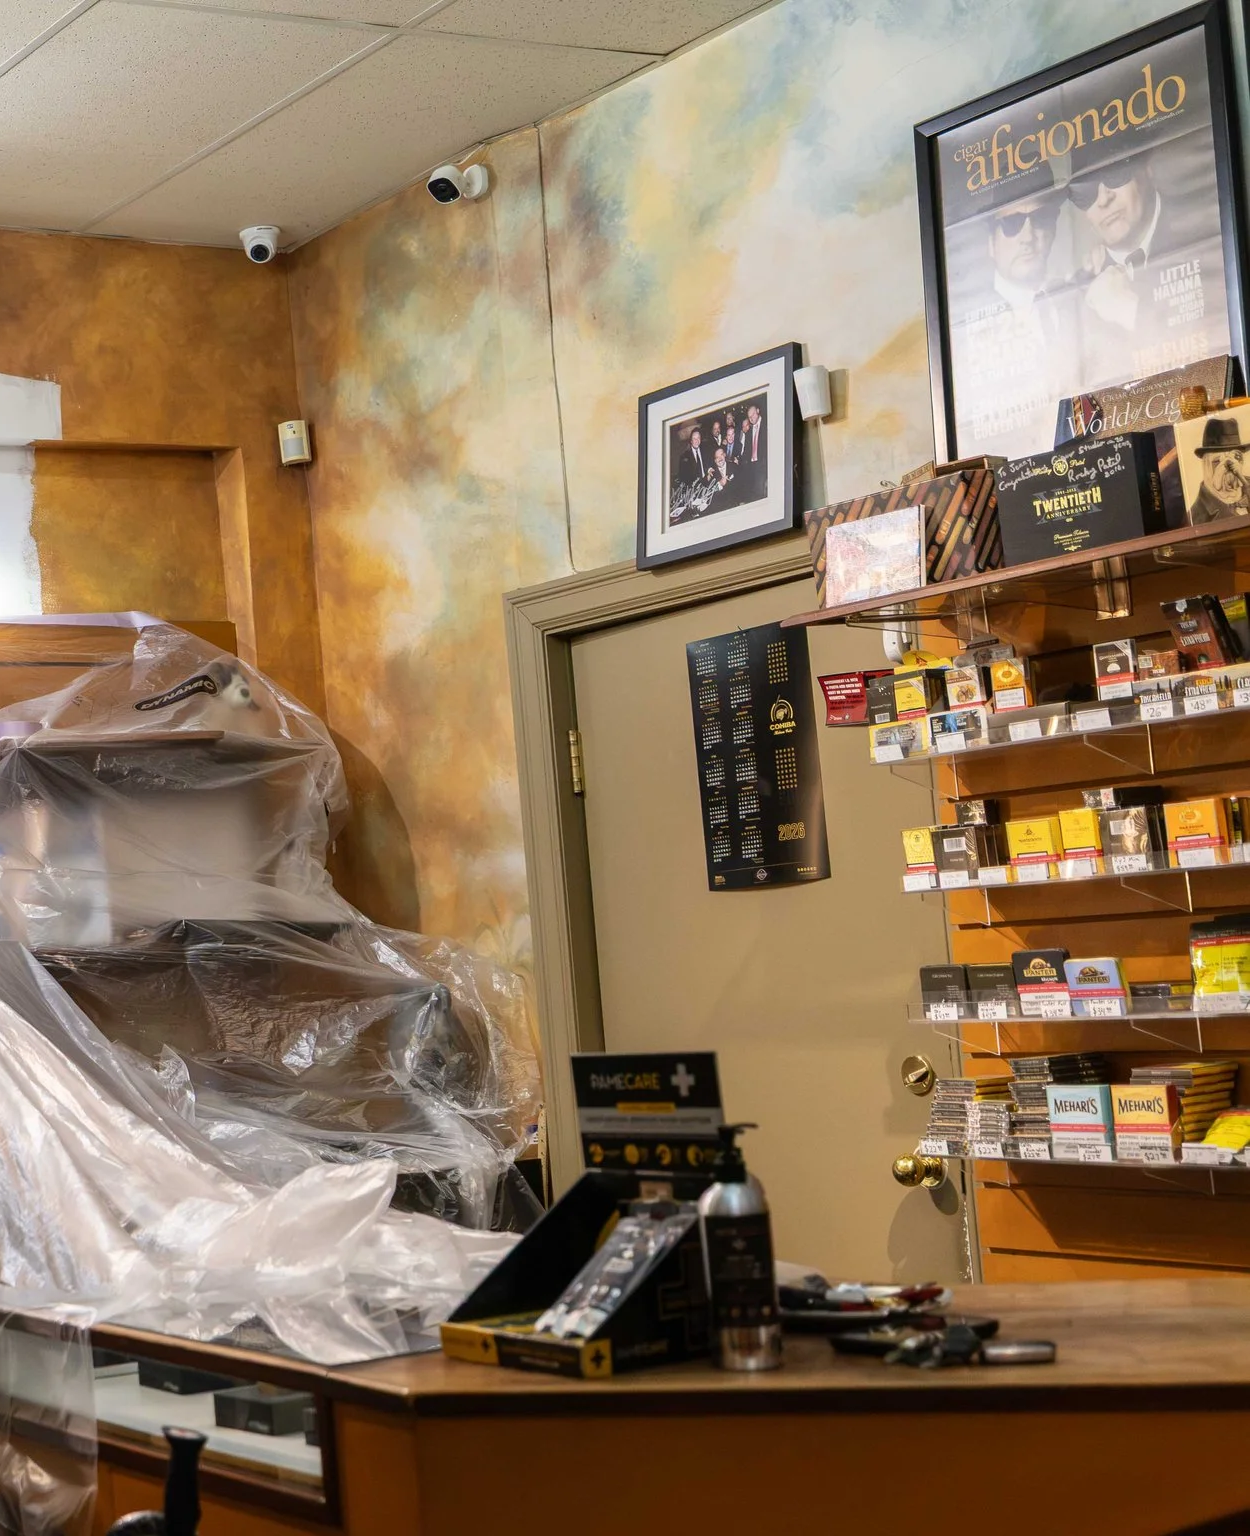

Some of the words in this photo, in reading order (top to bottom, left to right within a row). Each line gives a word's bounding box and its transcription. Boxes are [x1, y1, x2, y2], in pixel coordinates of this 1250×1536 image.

[966, 63, 1186, 192] aficionado
[953, 137, 989, 163] cigar
[1160, 259, 1201, 285] LITTLE
[1153, 274, 1203, 302] HAVANA
[1066, 401, 1132, 439] World
[1131, 403, 1143, 425] of
[1033, 486, 1103, 517] TWENTIETH
[1046, 505, 1092, 520] ANNIVERSARY
[140, 679, 216, 710] DYNAMIC
[770, 721, 796, 731] COHIBA
[778, 821, 806, 841] 2026
[1025, 969, 1055, 977] PANTER
[1053, 1097, 1098, 1115] MEHARI'S
[1118, 1096, 1164, 1115] MEHARI'S
